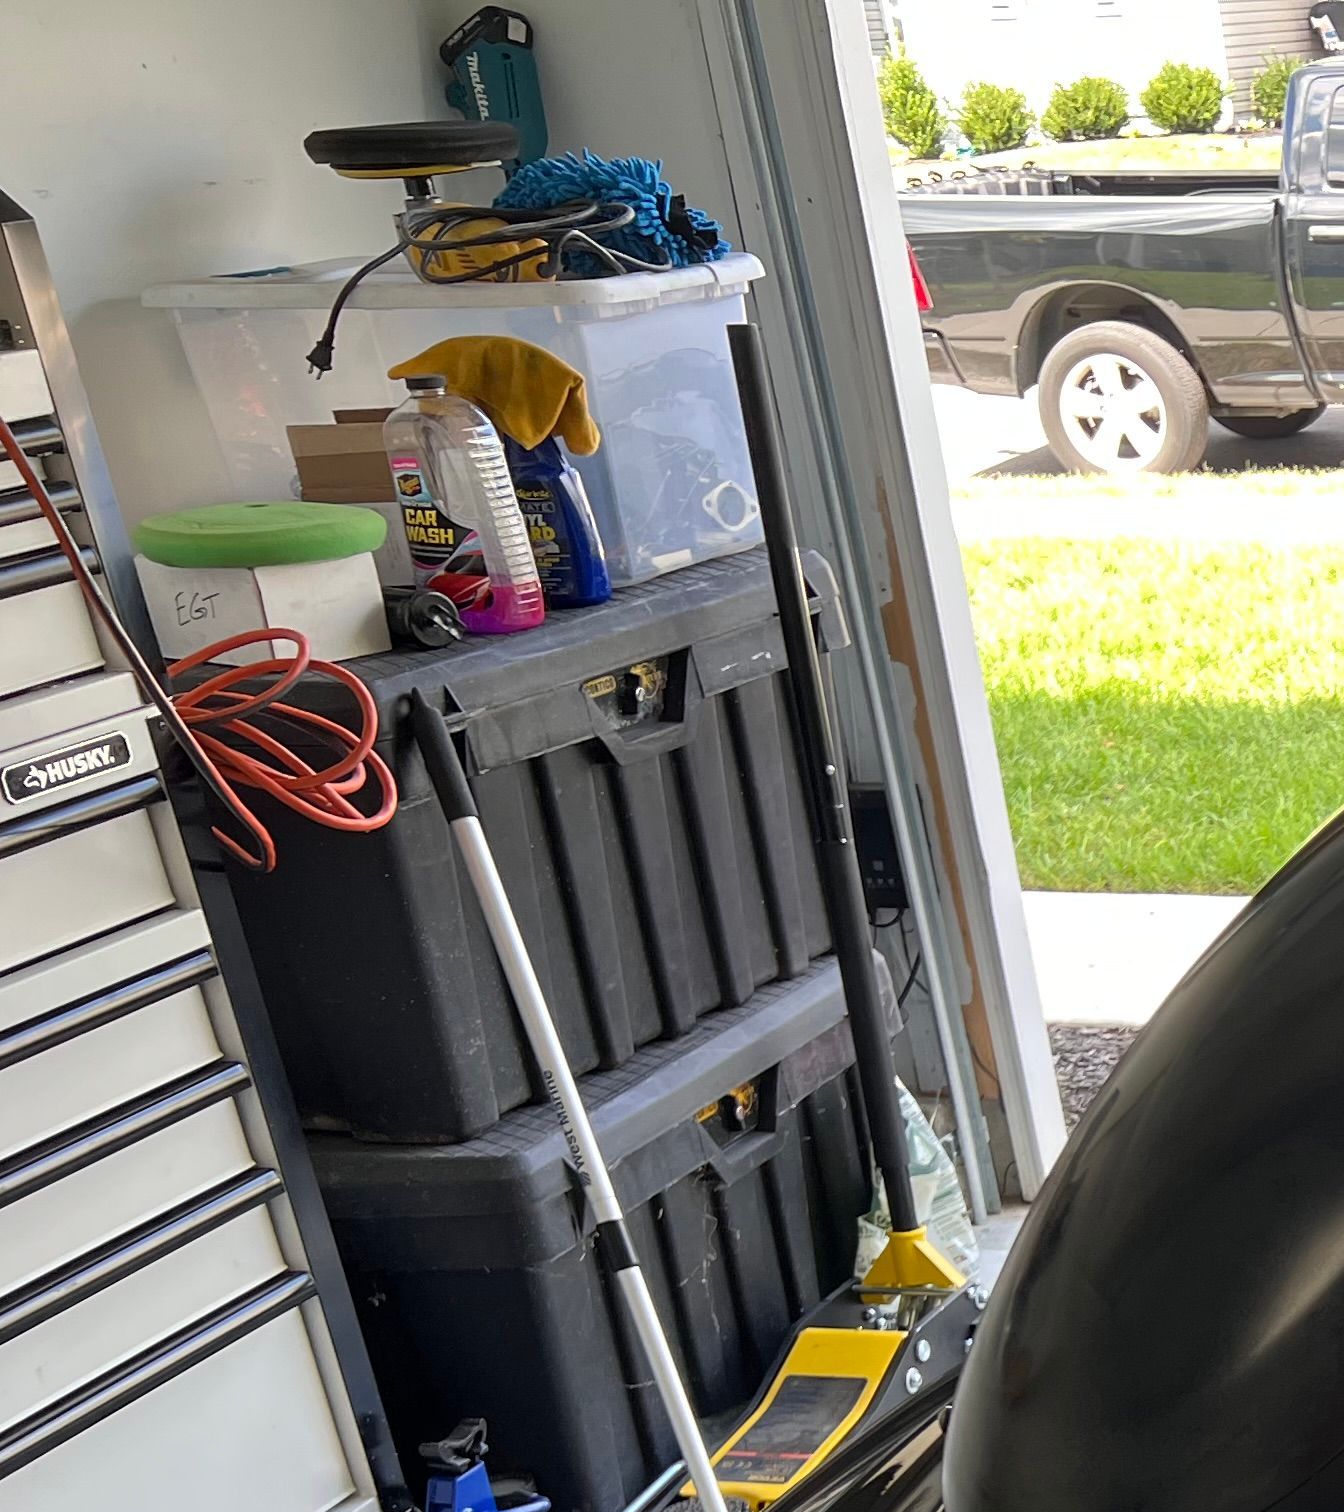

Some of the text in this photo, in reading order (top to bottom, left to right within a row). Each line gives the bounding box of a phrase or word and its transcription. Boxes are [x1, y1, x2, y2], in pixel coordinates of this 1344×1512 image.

[404, 508, 438, 526] CAR
[407, 525, 455, 545] WASH
[175, 591, 220, 627] EGT
